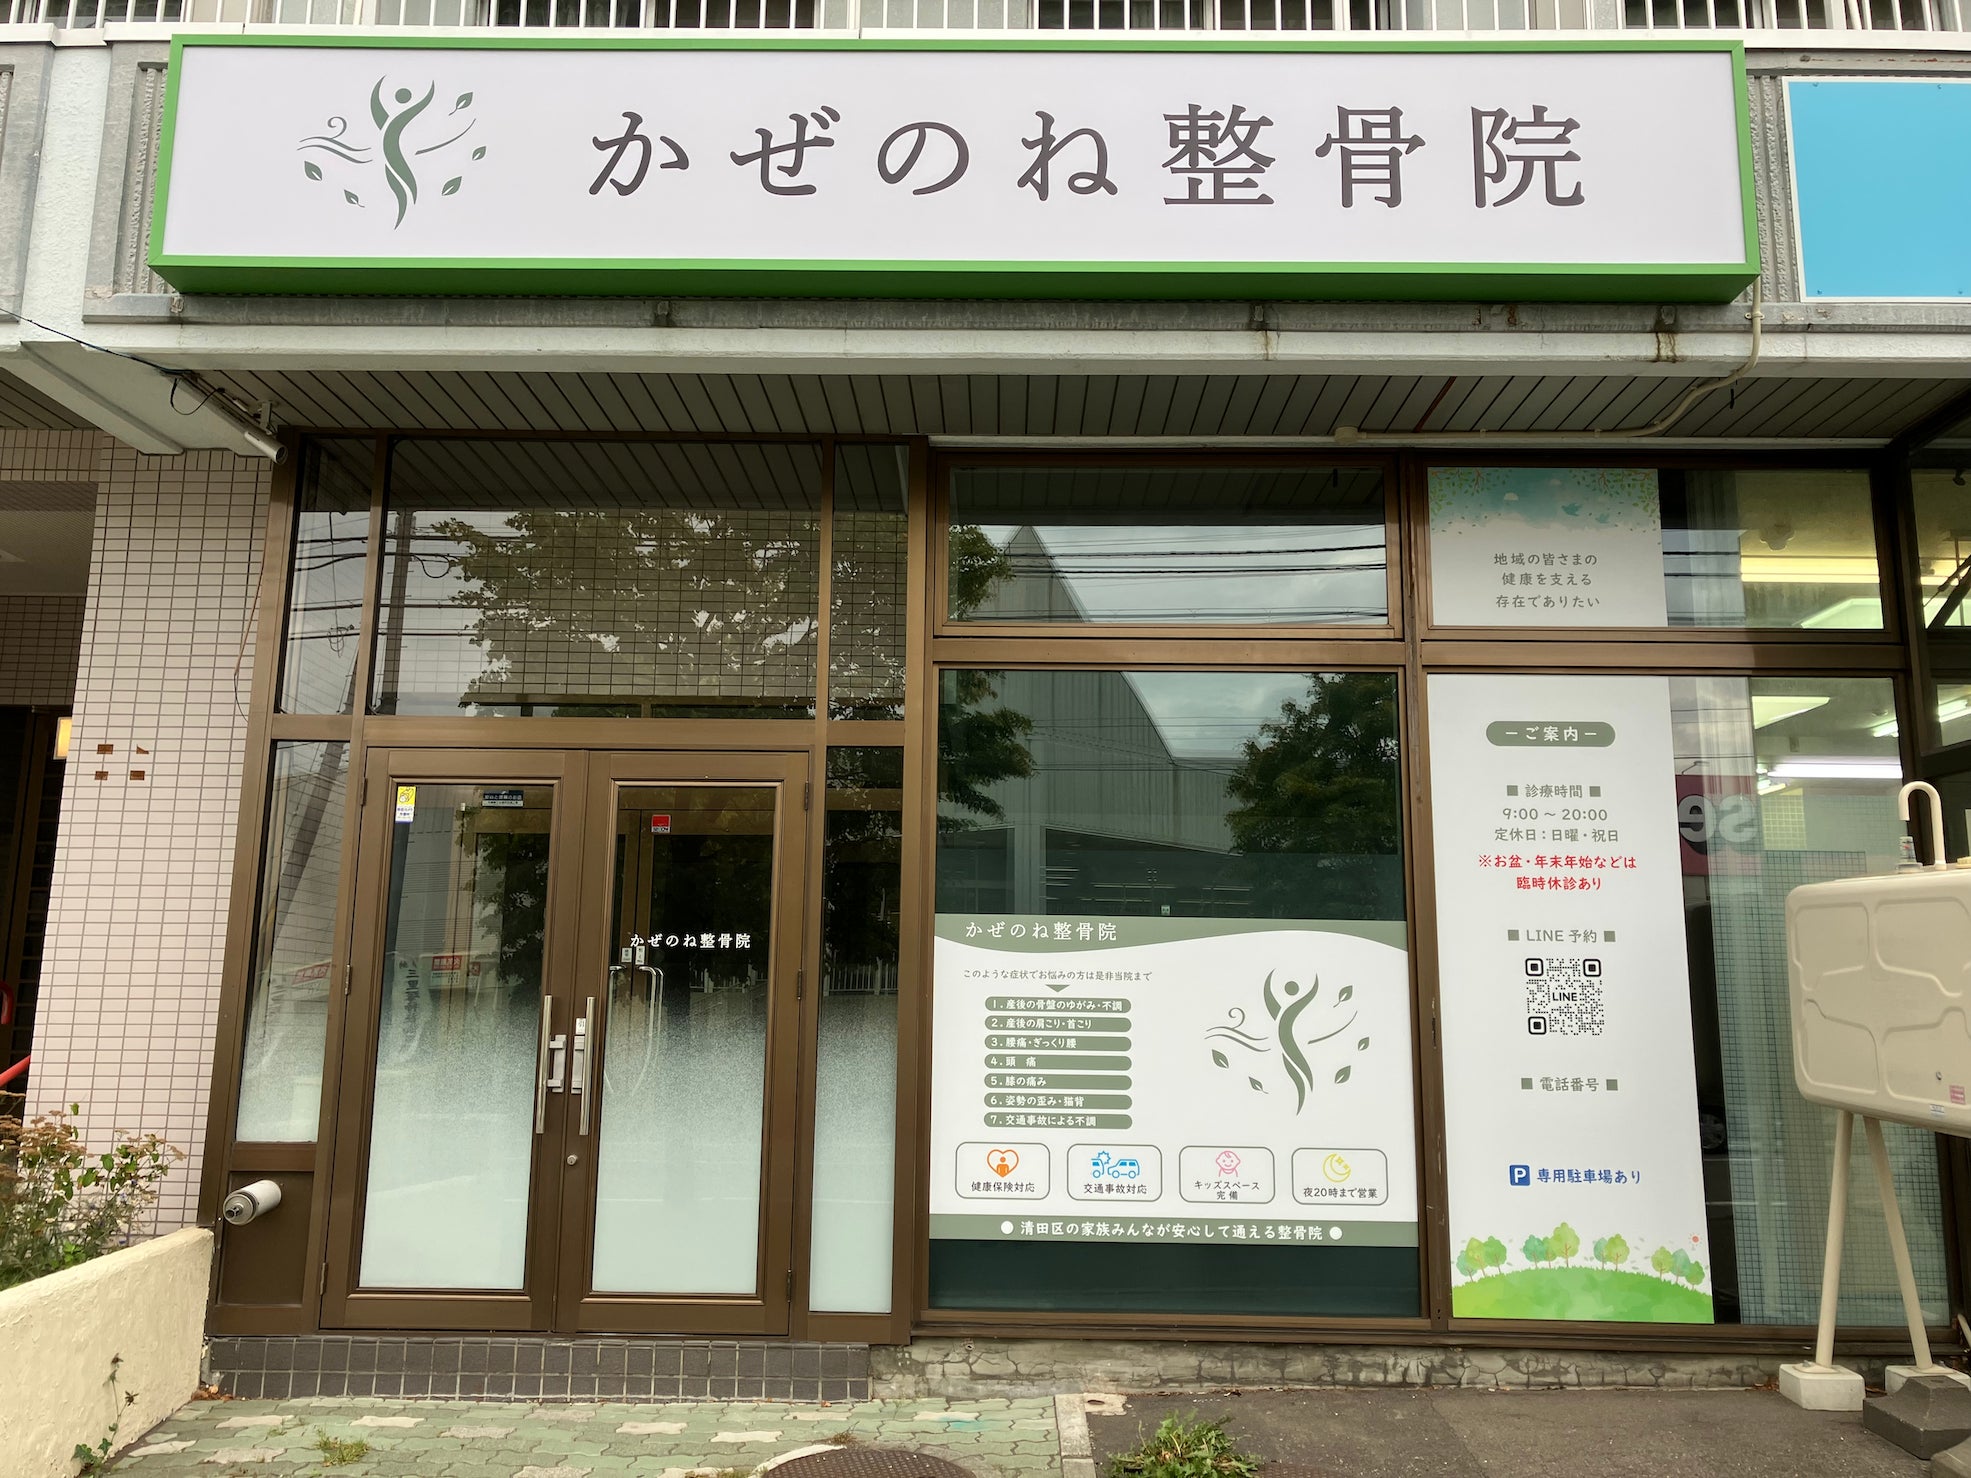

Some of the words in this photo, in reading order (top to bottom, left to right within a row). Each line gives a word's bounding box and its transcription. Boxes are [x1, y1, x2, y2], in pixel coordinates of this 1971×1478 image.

[588, 104, 1587, 209] かぜのね整骨院
[1493, 552, 1598, 566] 地域の皆さまの
[1502, 572, 1592, 586] 健康を支える
[1496, 595, 1600, 608] 存在でありたい
[1525, 784, 1583, 798] 診療時間
[1516, 876, 1602, 891] 臨時休診あり
[965, 922, 1117, 941] かぜのね整骨院
[630, 933, 751, 949] かぜのね整骨院
[963, 969, 1152, 982] このような症状でお悩みの方は是非当院まで
[1552, 992, 1578, 1001] LINE
[1540, 1077, 1600, 1092] 電話番号
[1537, 1168, 1641, 1184] 専用駐車場あり
[971, 1181, 1036, 1193] 健康保険対応
[1083, 1183, 1148, 1195] 交通事故対応
[1194, 1180, 1260, 1190] キッズスペース
[1303, 1187, 1378, 1199] 夜20時まで営業
[1020, 1221, 1323, 1240] 清田区の家族みんなが安心して通える整骨院
